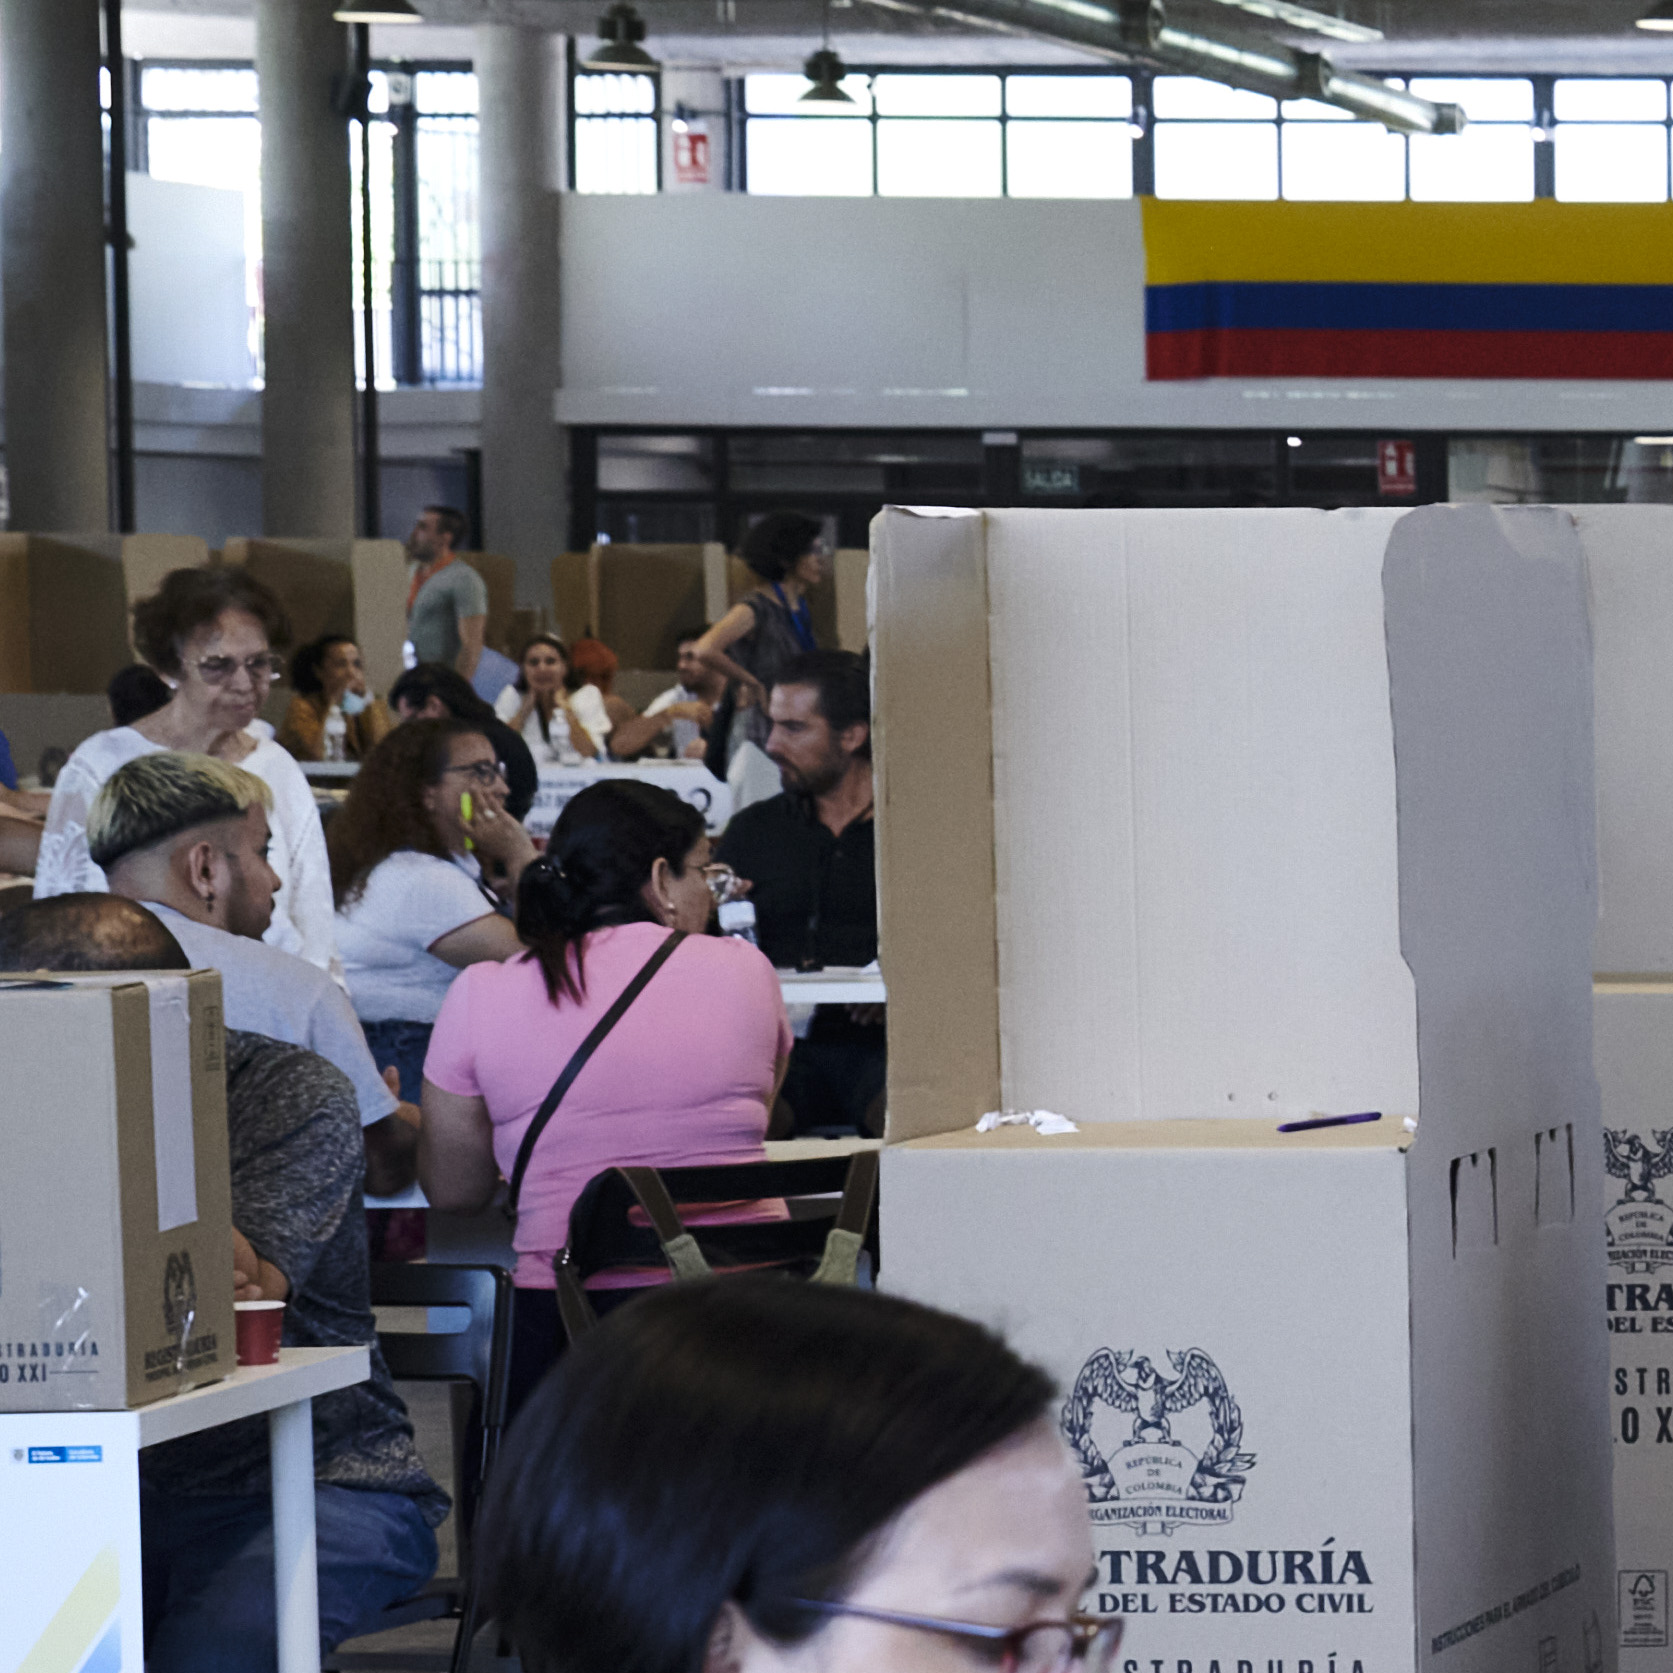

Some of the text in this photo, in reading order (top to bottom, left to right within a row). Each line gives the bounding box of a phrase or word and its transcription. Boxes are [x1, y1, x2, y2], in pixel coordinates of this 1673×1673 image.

[18, 1363, 46, 1383] XXI
[1125, 1456, 1183, 1470] REPÚBLICA
[1147, 1468, 1161, 1476] DE
[1125, 1482, 1183, 1495] COLOMBIA
[1165, 1505, 1229, 1520] ELECTORAL
[1099, 1537, 1373, 1585] TRADURÍA
[1100, 1593, 1374, 1613] DEL ESTADO CIVIL
